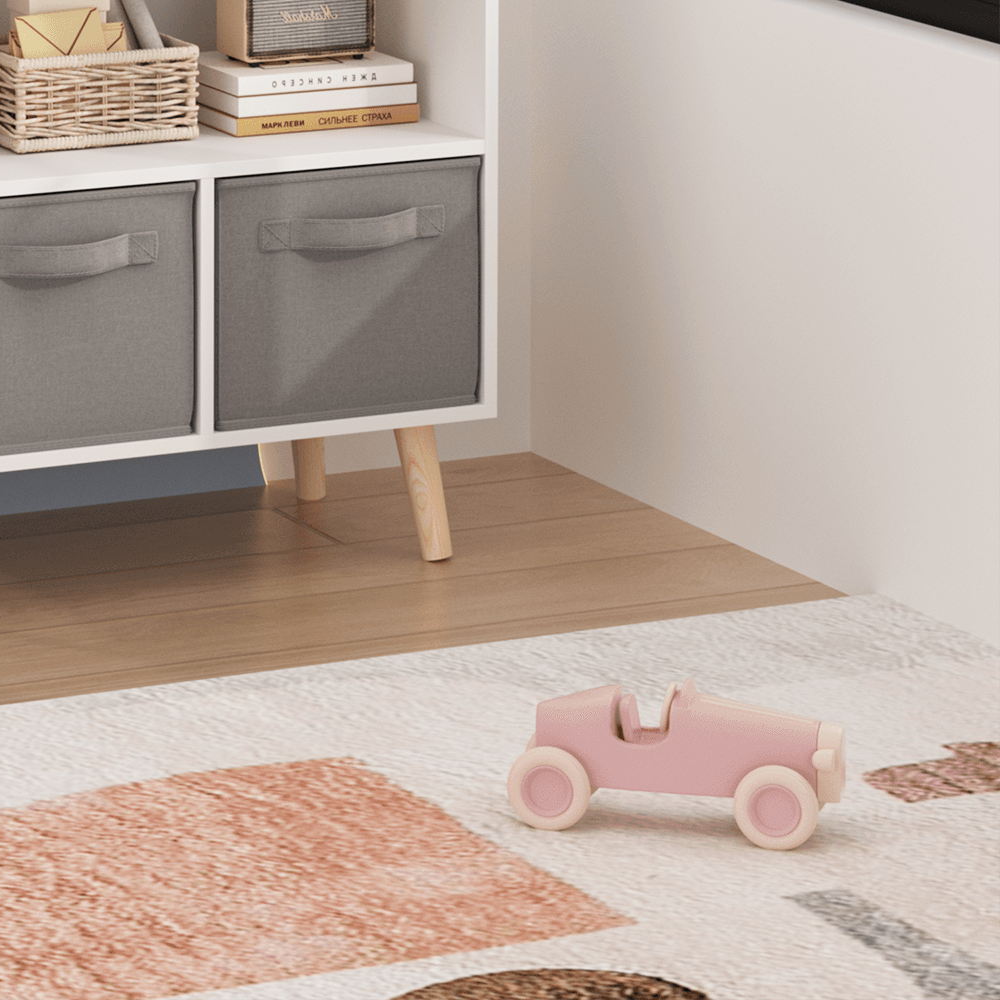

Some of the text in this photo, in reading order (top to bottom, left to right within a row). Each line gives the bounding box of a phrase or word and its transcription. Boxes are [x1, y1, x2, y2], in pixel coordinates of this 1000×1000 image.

[261, 112, 392, 130] МАРК ЛЕВИ СИЛЬНЕЕ СТРАХА
